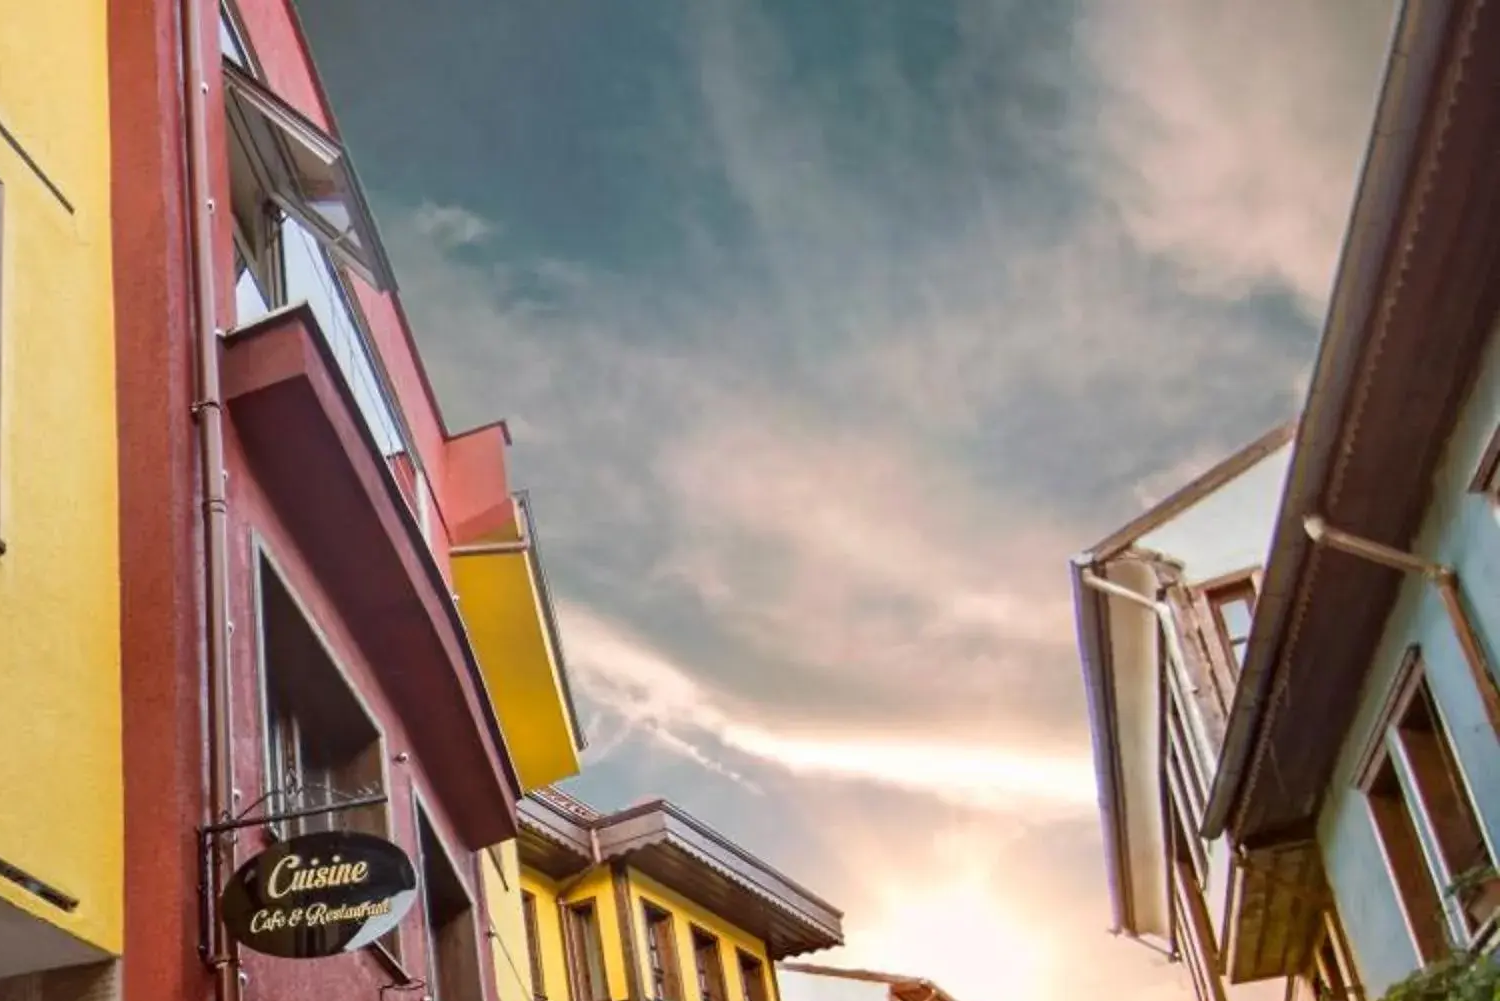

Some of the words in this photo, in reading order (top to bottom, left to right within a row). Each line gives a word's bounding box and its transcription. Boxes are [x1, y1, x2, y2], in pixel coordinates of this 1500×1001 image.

[267, 854, 369, 899] Cuisine
[250, 909, 286, 934] Cafe
[288, 908, 303, 928] &
[306, 898, 390, 927] Restaurant
